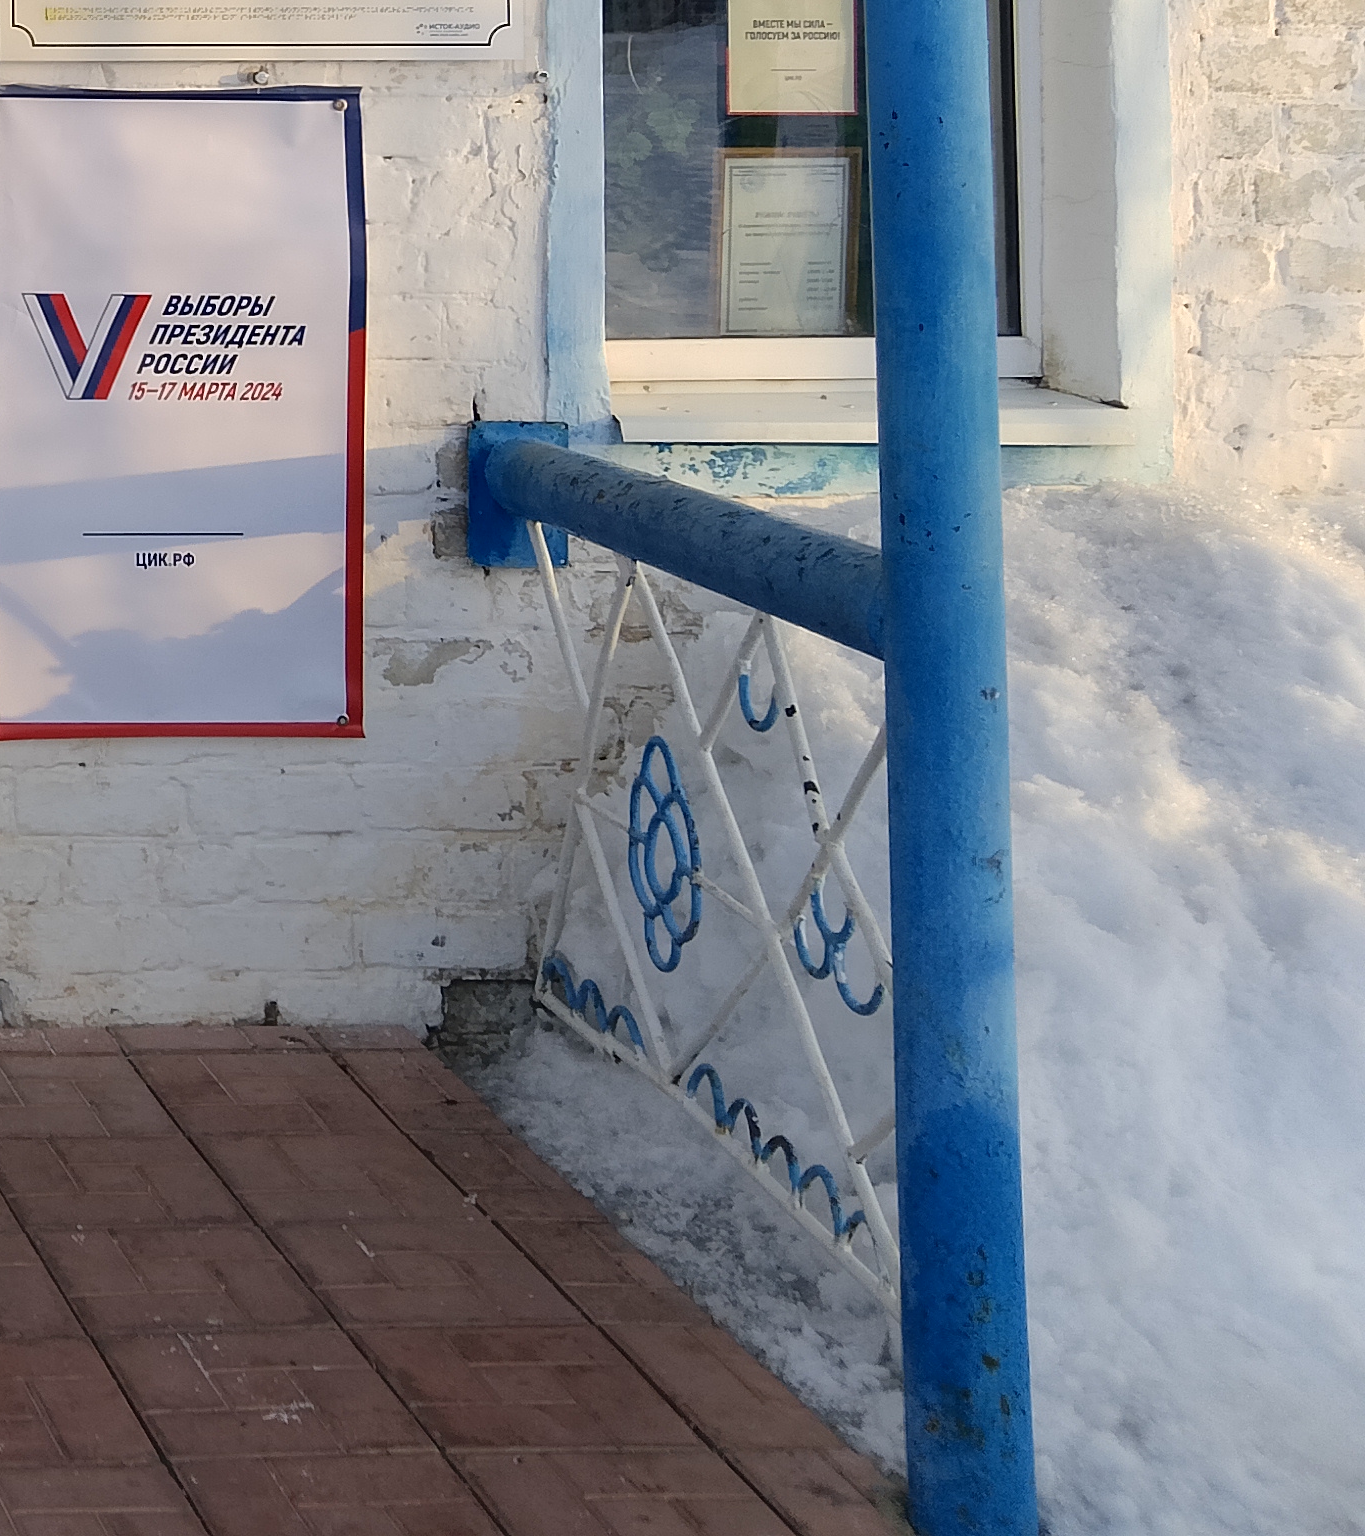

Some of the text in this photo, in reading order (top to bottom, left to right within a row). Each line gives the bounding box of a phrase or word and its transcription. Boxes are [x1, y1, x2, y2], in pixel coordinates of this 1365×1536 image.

[752, 19, 785, 29] ВМЕСТЕ
[786, 19, 802, 29] МЫ
[802, 19, 826, 29] СИЛА
[745, 31, 789, 41] ГОЛОСУЕМ
[162, 295, 276, 317] ВЫБОРЫ
[148, 324, 307, 349] ПРЕЗИДЕНТА
[136, 353, 239, 375] РОССИИ
[177, 382, 238, 401] МАРТА
[239, 382, 283, 401] 2024
[135, 552, 196, 570] ЦИК.РФ
